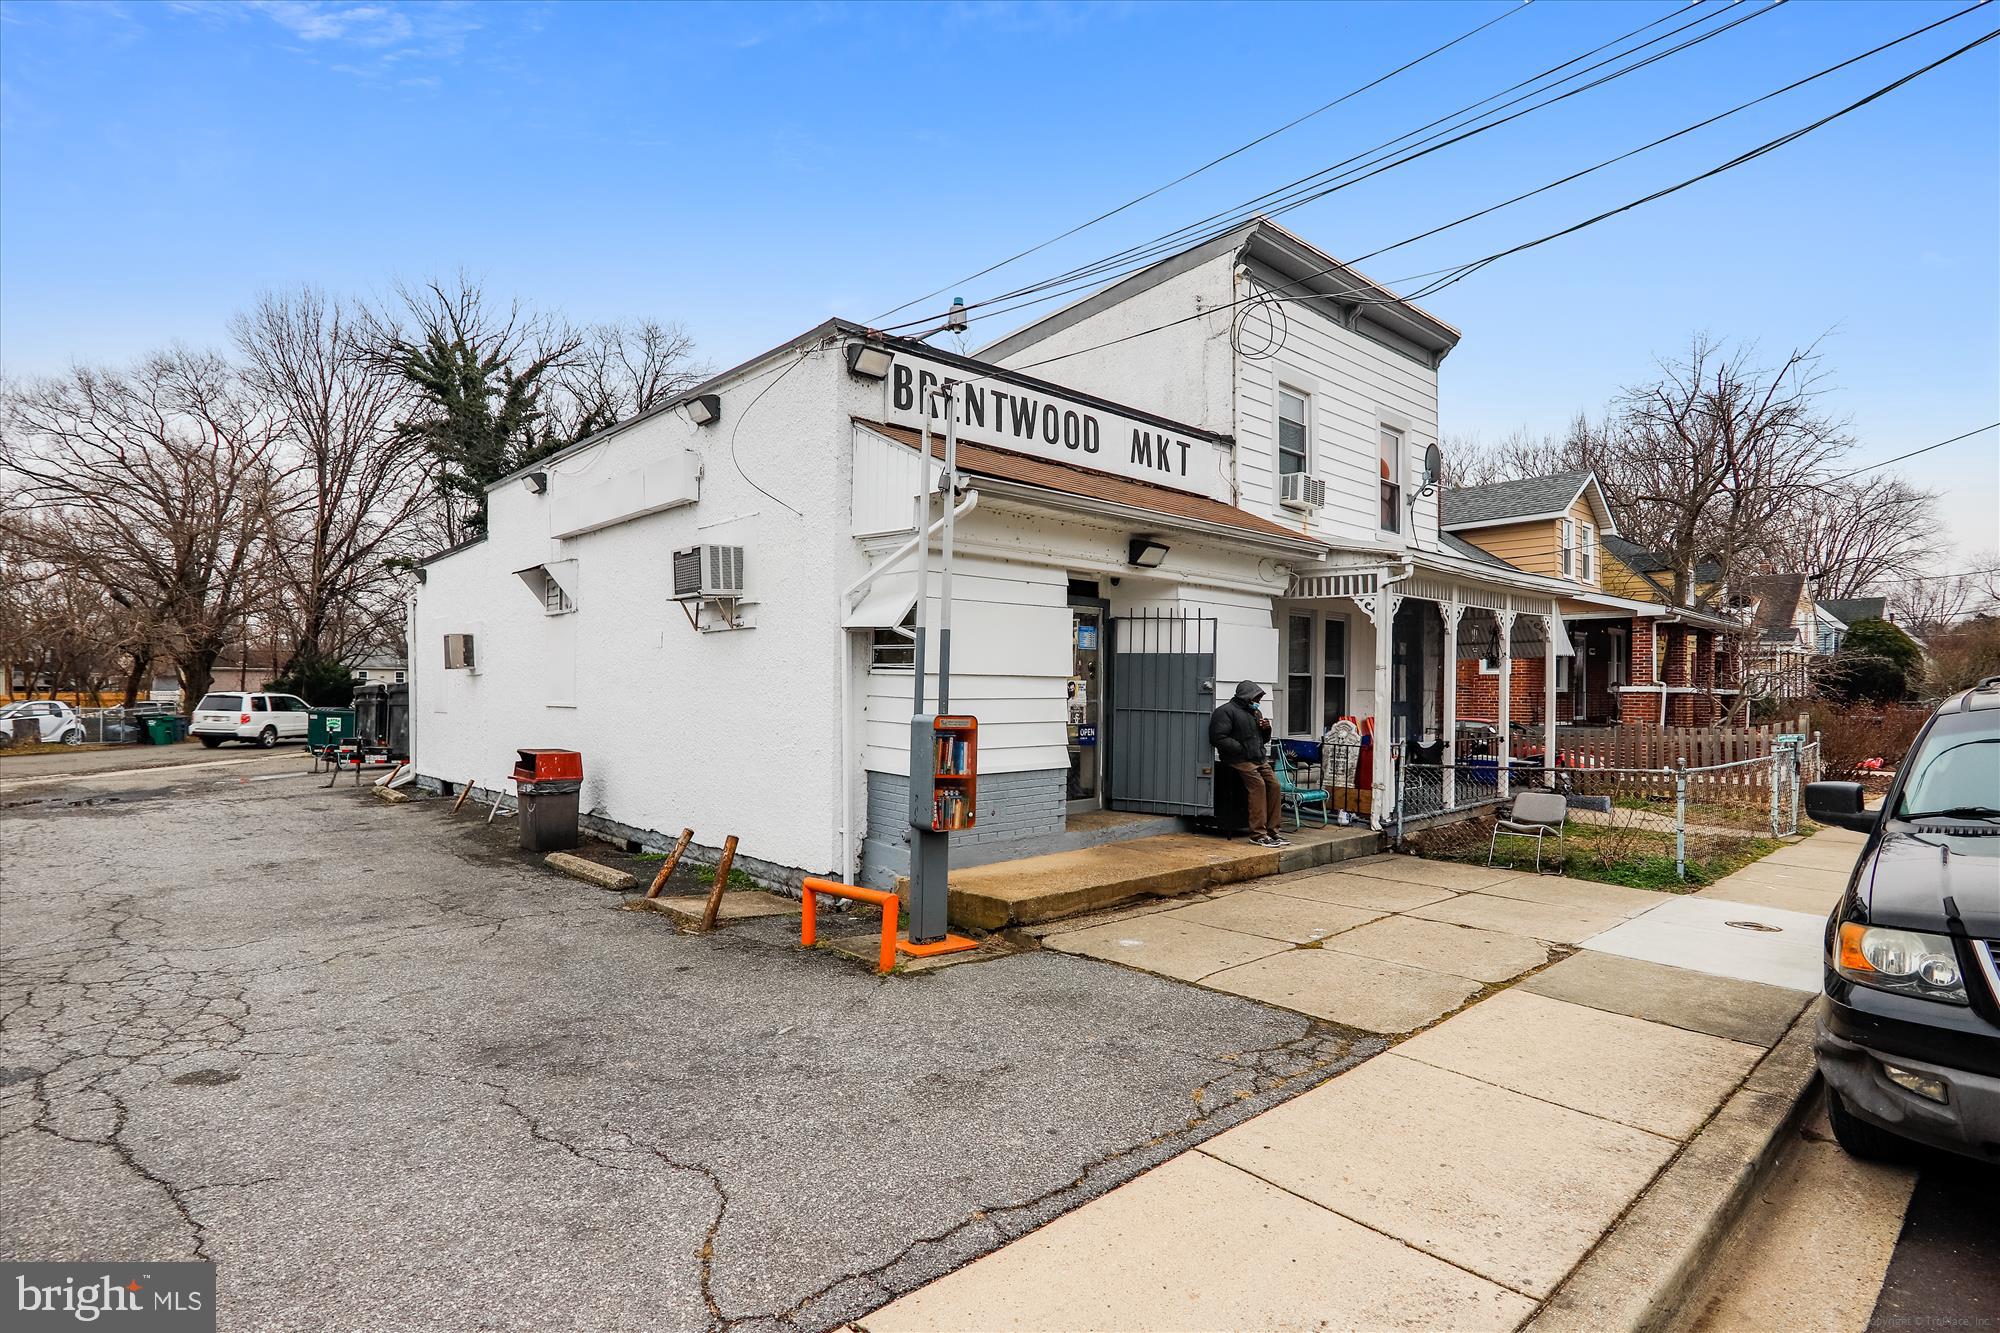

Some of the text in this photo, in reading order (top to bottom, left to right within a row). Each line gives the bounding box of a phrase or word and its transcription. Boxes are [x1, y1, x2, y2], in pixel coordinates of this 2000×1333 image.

[893, 363, 1192, 477] BRENTWOOD MKT
[1079, 727, 1095, 737] OPEN
